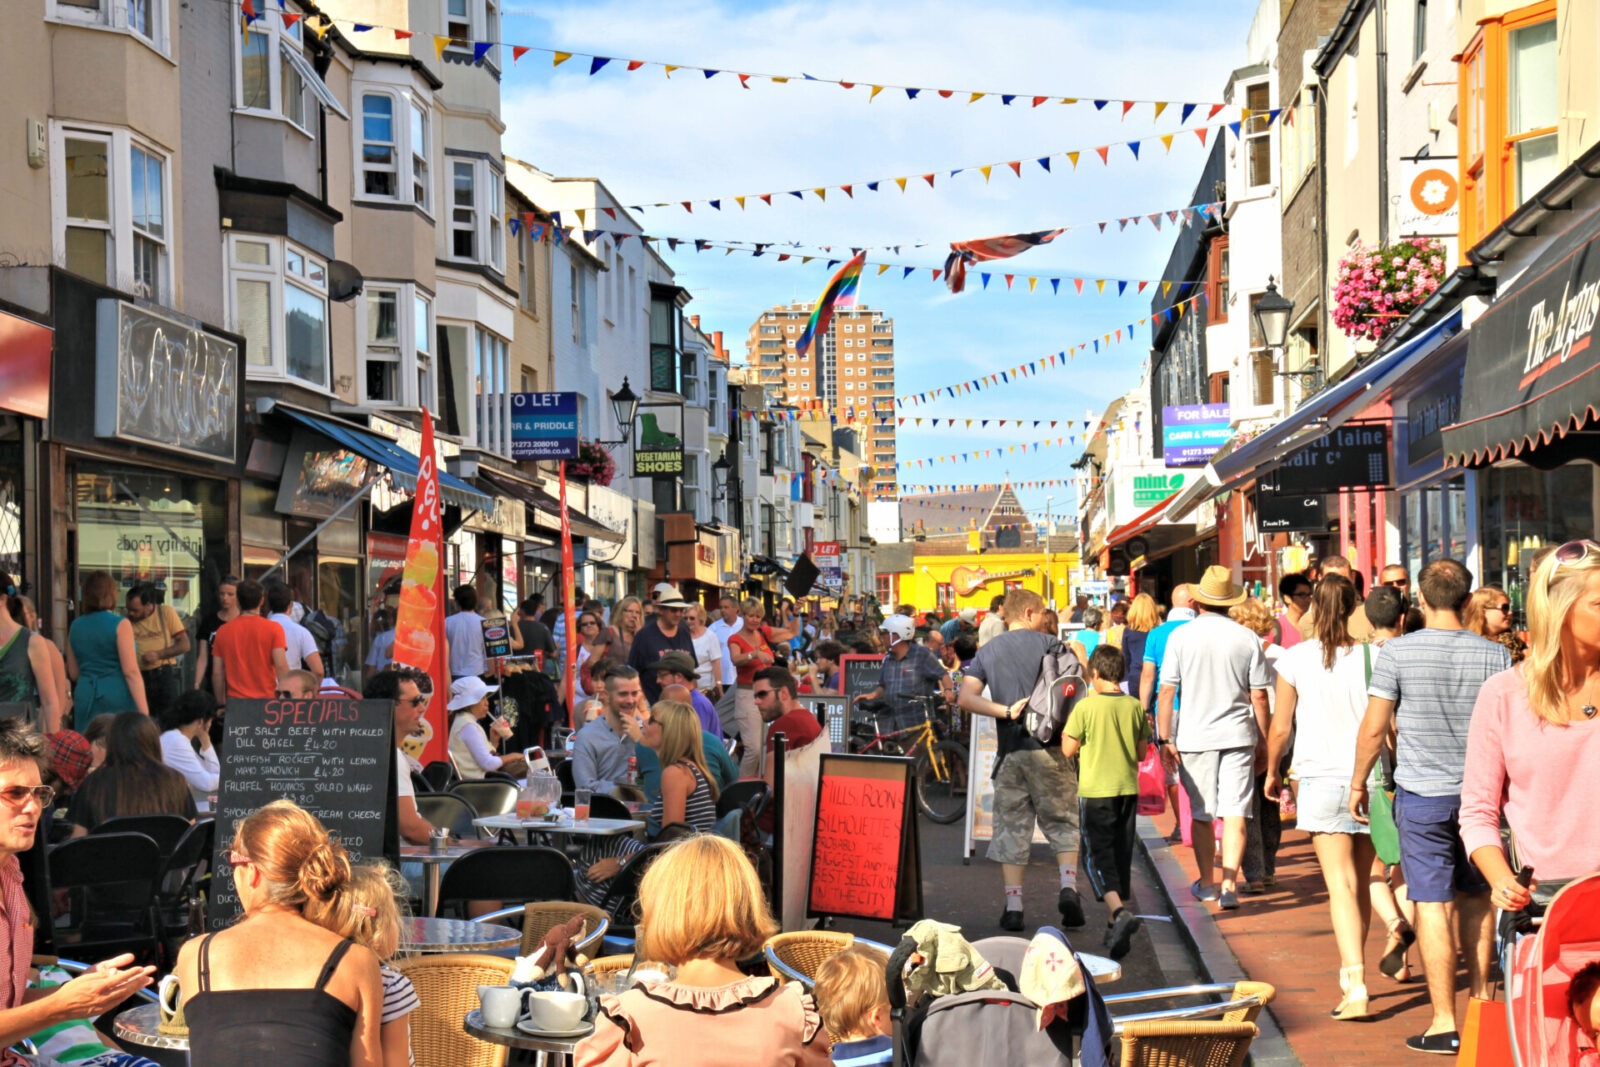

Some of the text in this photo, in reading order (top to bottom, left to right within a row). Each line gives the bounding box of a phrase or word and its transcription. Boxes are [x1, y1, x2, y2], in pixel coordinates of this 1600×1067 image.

[1523, 298, 1554, 374] The
[532, 393, 561, 407] LET
[1177, 408, 1230, 420] FOR SALE
[524, 422, 531, 431] &
[534, 421, 575, 430] PRIDDLE
[1337, 429, 1383, 446] laine
[533, 440, 559, 448] 208010
[635, 451, 682, 462] VEGETARIAN
[636, 462, 682, 473] SHOES
[1133, 473, 1168, 489] mint
[264, 700, 360, 725] SPECIALS
[228, 727, 384, 737] HOT SALT BEEF WITH PICKLED
[236, 737, 338, 751] DILL BAGEL £4.20
[226, 755, 377, 765] CRAYFISH ROCKET WITH LEMON
[235, 766, 345, 778] MAYO SANDWICH £4.20
[224, 780, 263, 792] FALAFEL
[315, 782, 344, 793] SALAD
[347, 783, 373, 793] WRAP
[348, 810, 382, 820] CHEESE
[857, 891, 886, 907] CITY
